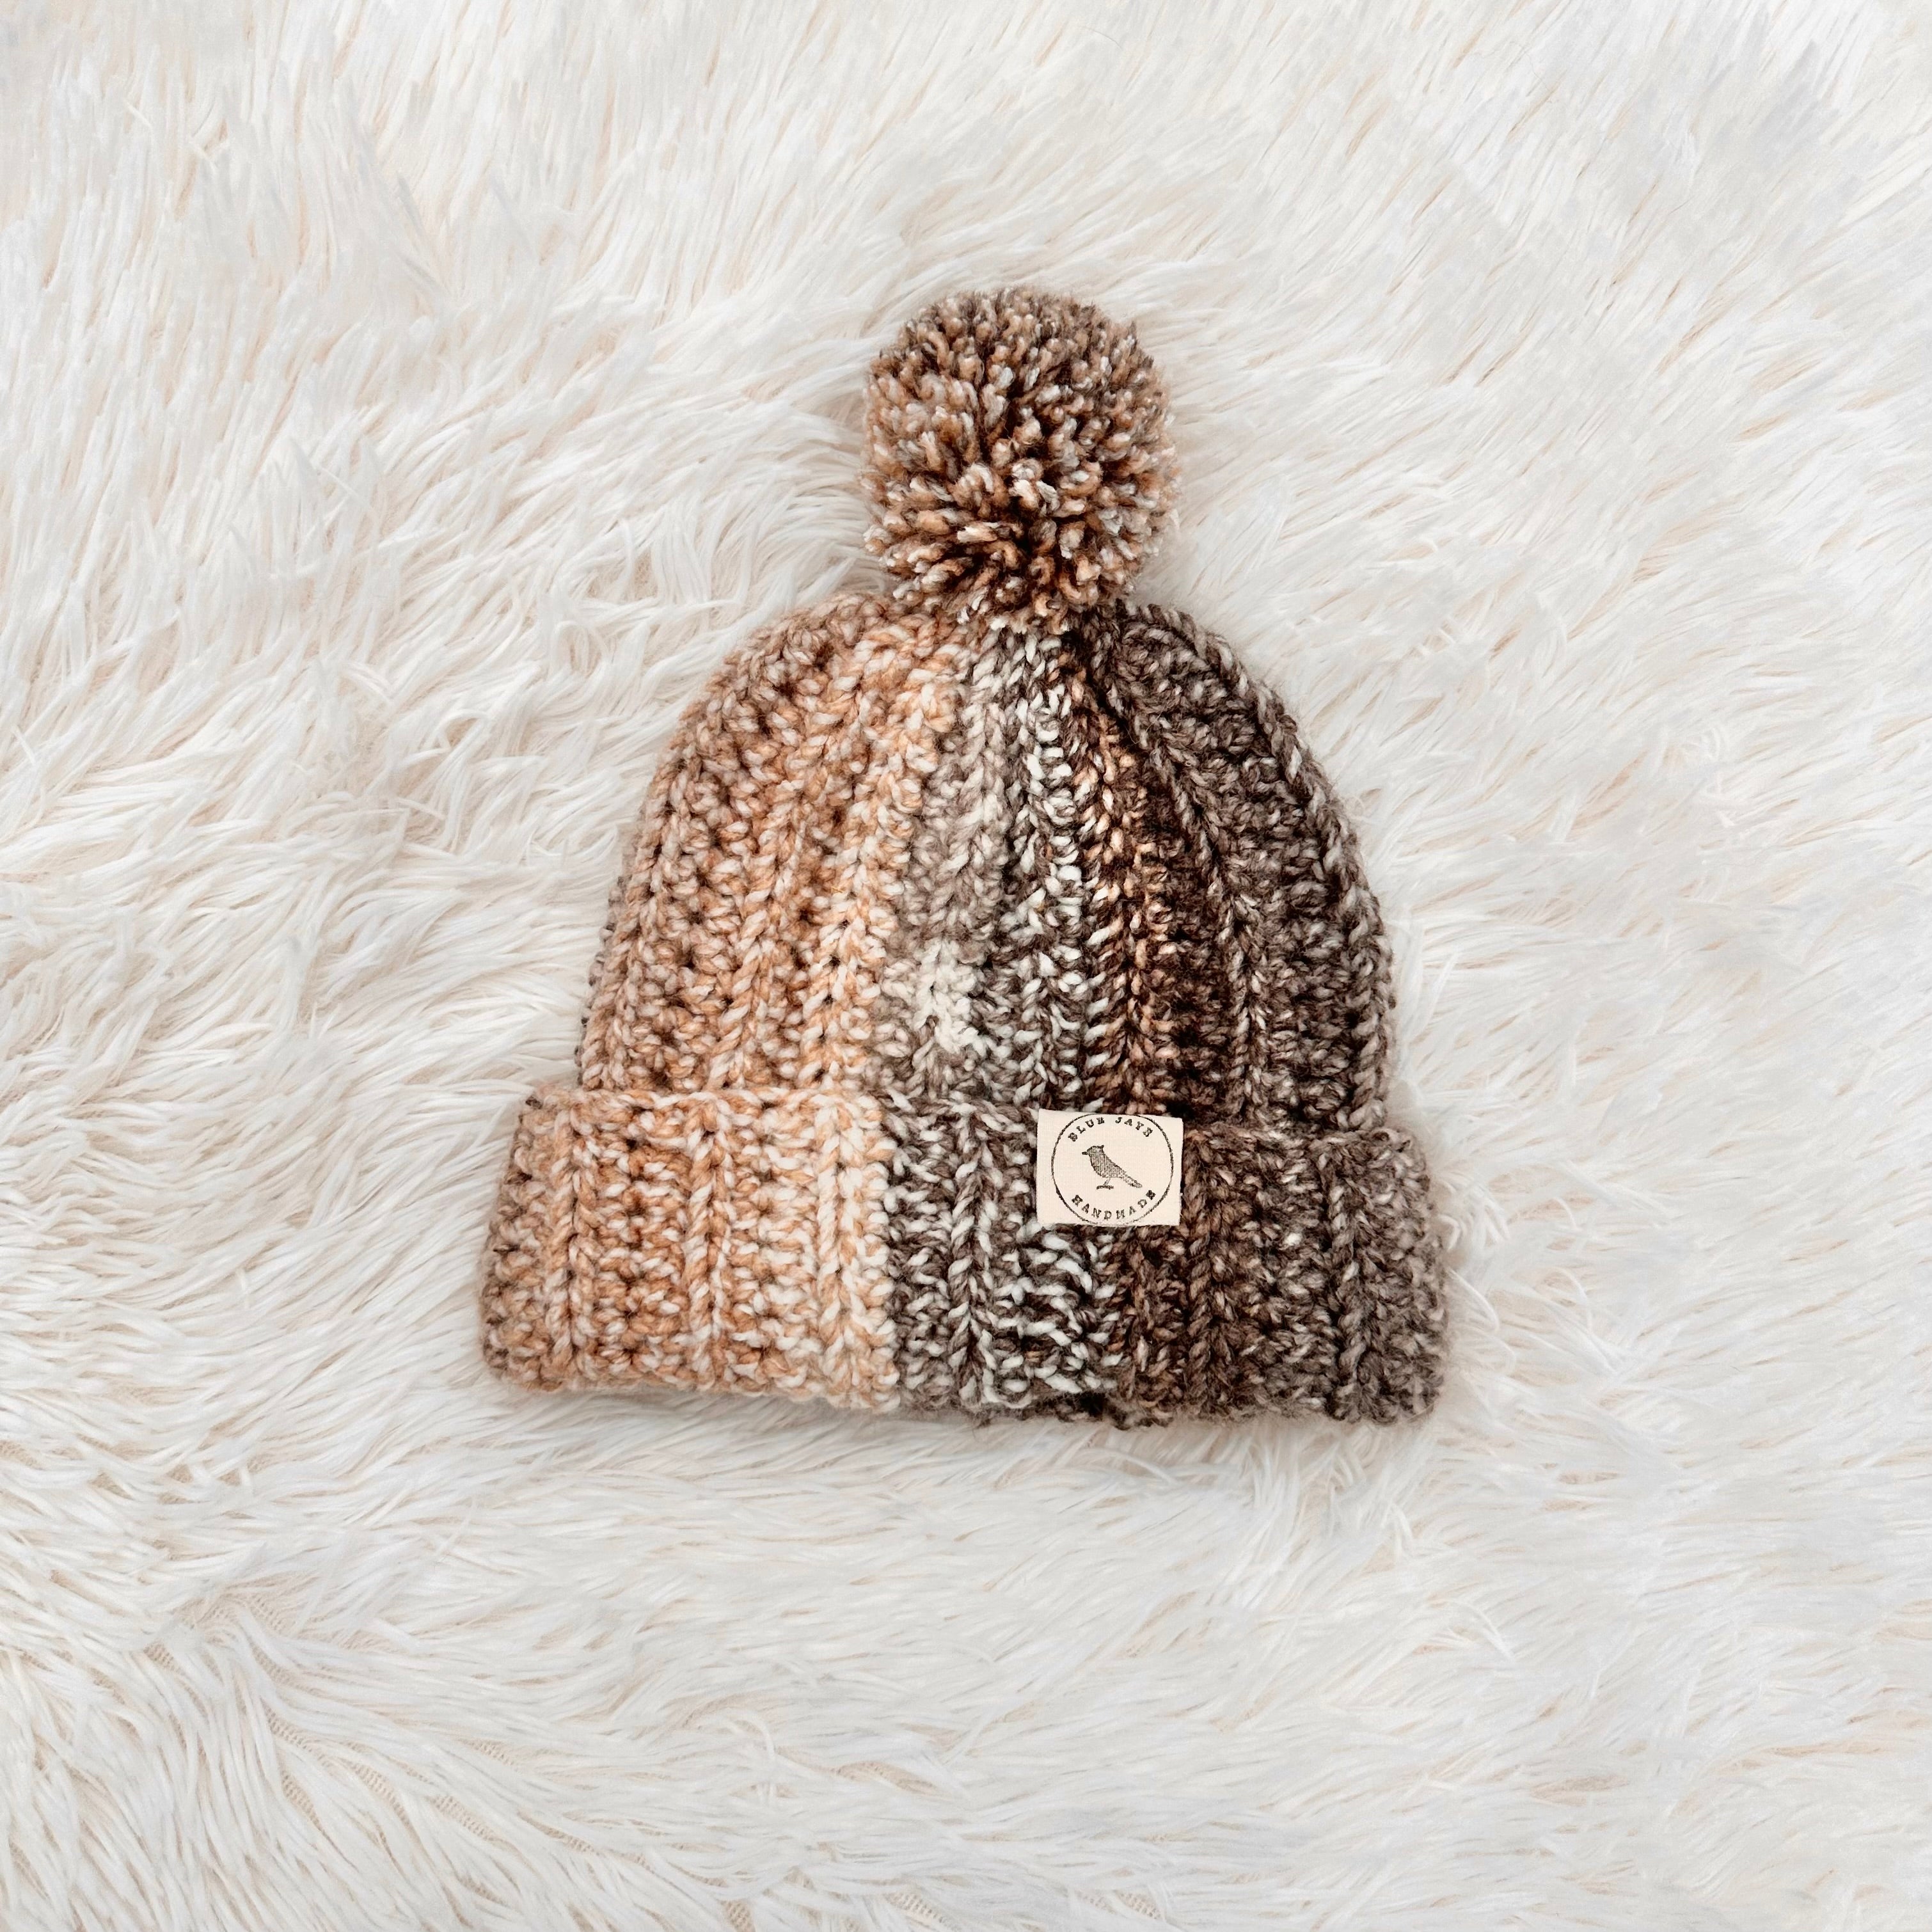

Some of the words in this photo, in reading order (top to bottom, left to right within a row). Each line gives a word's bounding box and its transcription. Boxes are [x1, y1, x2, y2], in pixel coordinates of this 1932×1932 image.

[1068, 1116, 1105, 1142] BLUE
[1114, 1116, 1153, 1137] JAYS
[1071, 1189, 1156, 1221] HANDMADE
